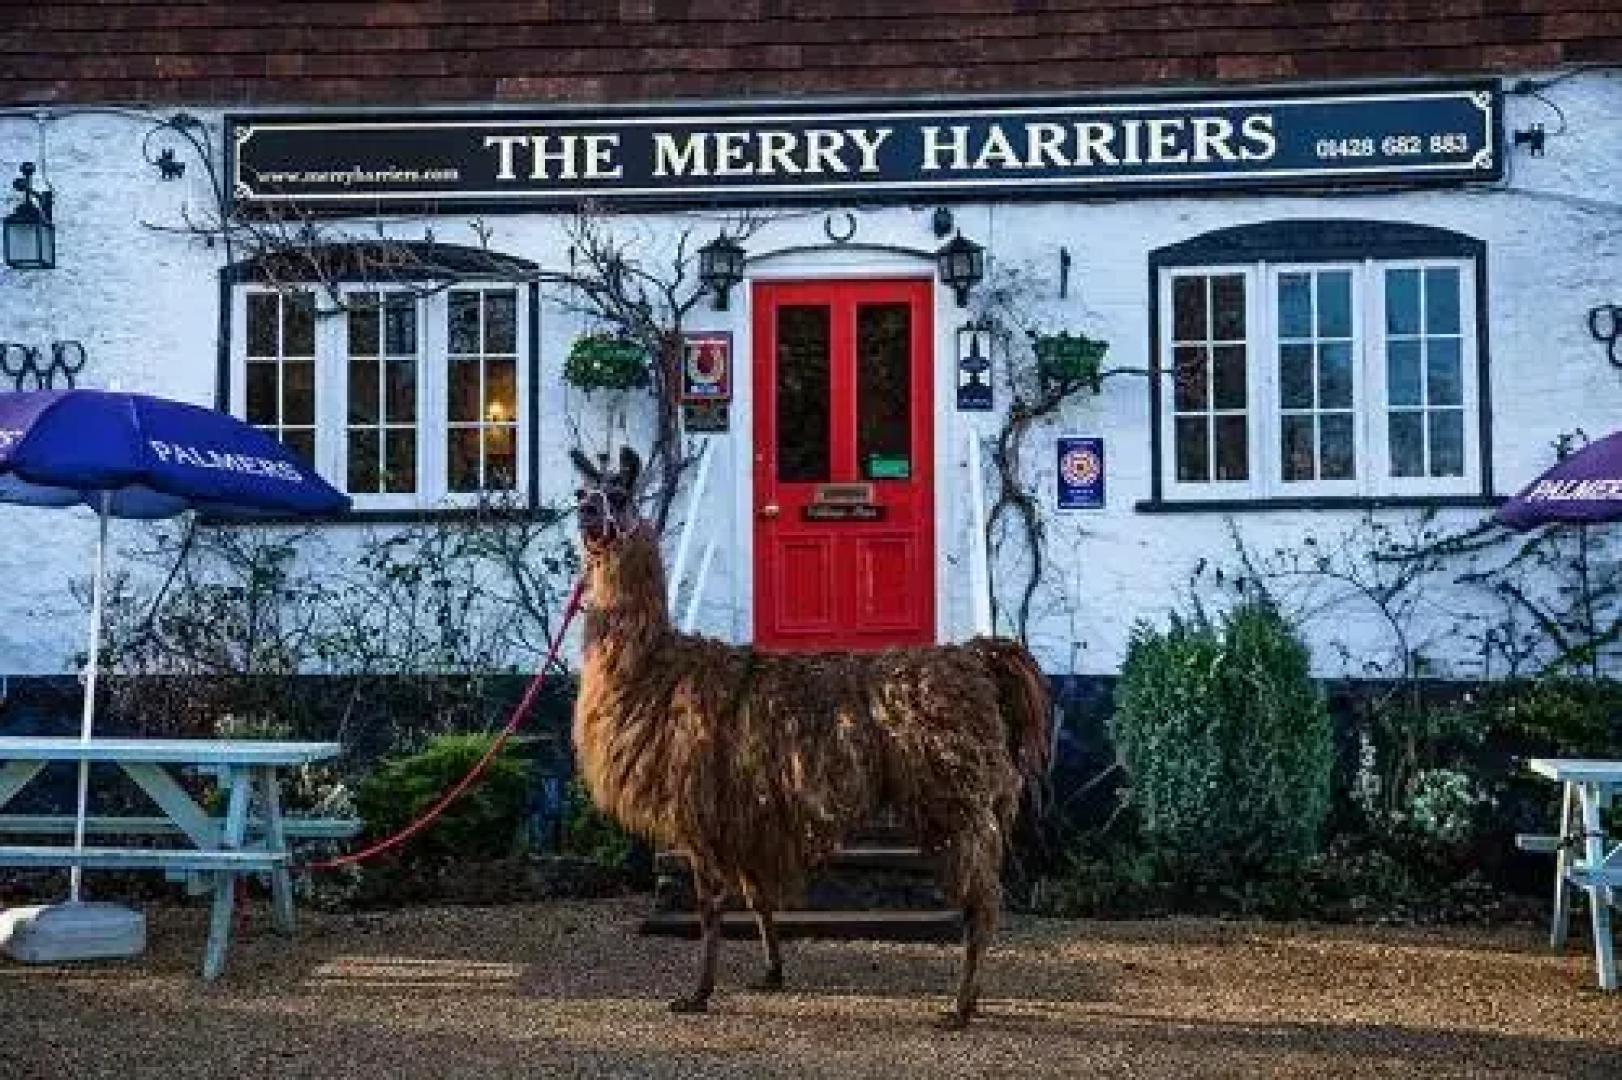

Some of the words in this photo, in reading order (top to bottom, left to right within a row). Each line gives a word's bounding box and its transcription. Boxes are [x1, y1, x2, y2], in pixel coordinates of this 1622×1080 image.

[484, 133, 622, 181] THE
[652, 128, 893, 176] MERRY
[920, 113, 1277, 171] HARRIERS
[149, 440, 303, 482] PALMERS
